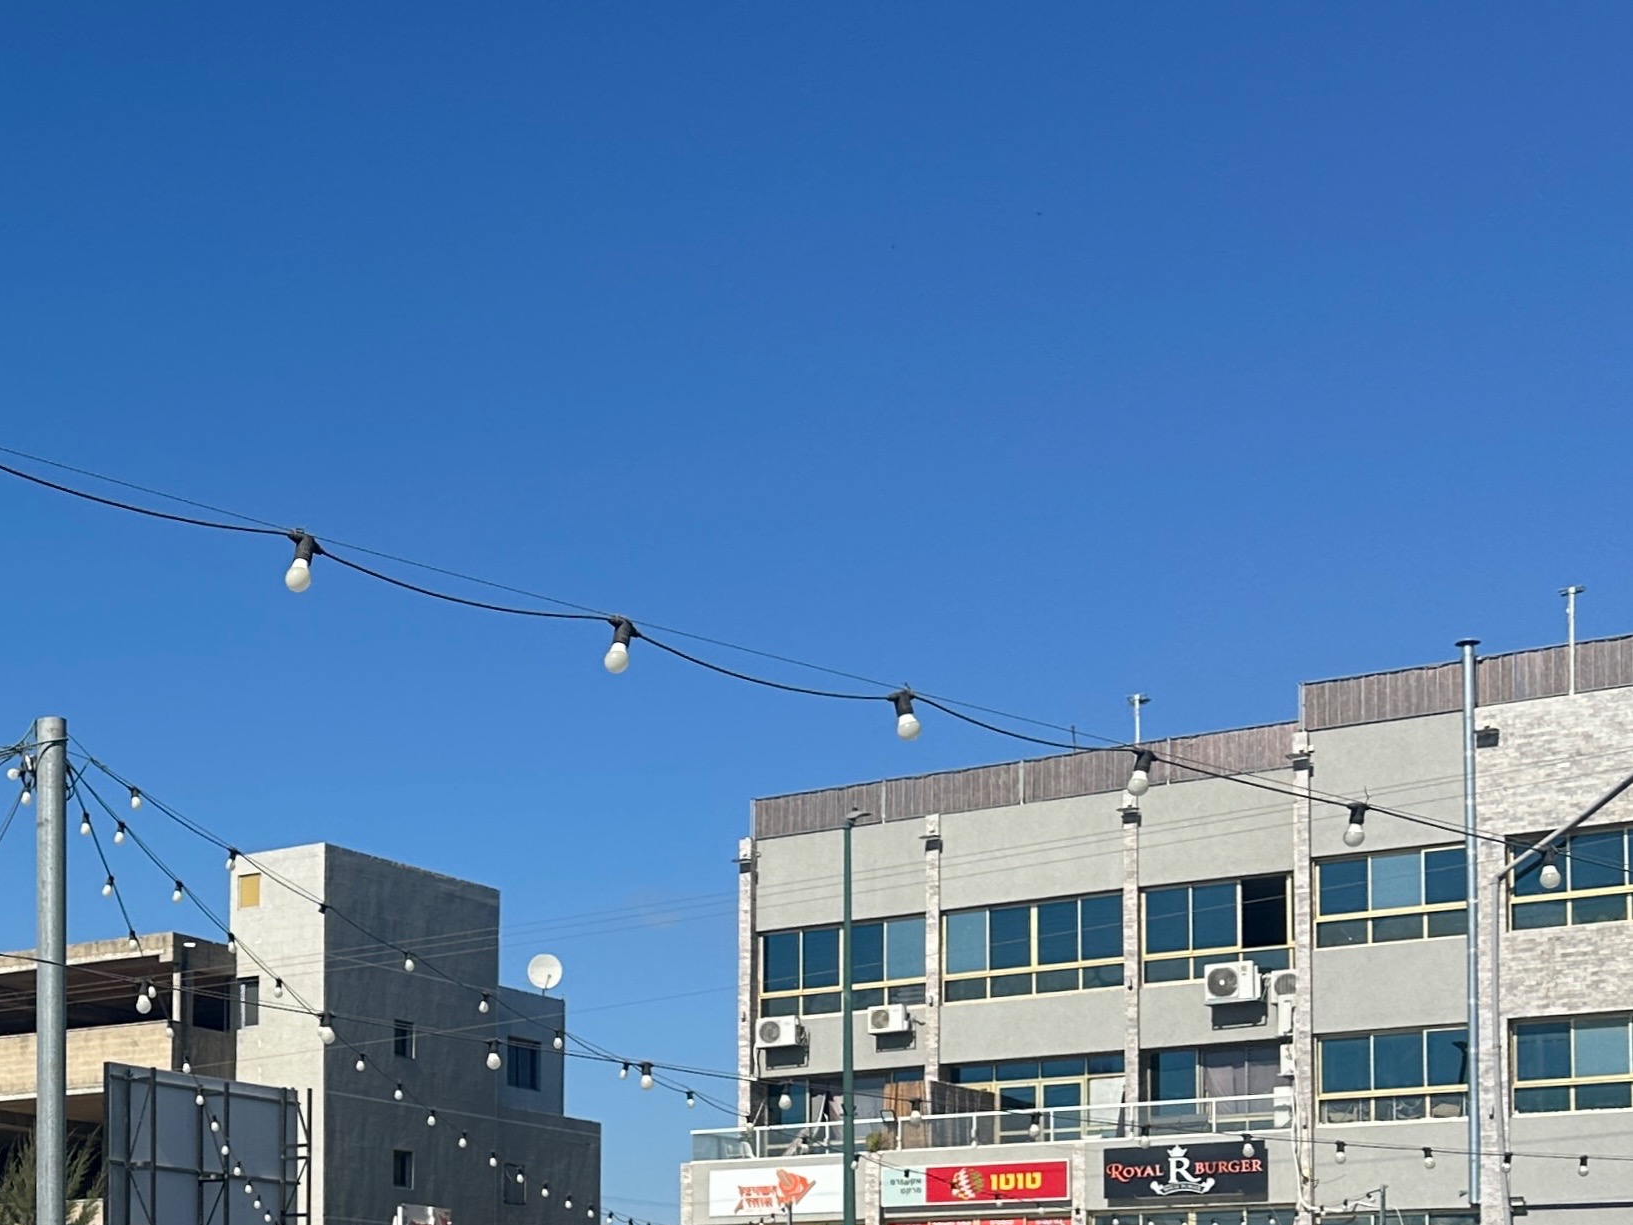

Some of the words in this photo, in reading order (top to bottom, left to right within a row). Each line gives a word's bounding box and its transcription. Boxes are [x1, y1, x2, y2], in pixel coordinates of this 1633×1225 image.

[1106, 1163, 1164, 1182] ROYAL
[1167, 1157, 1202, 1183] R
[1194, 1159, 1263, 1175] BURGER
[990, 1172, 1042, 1191] טוטו
